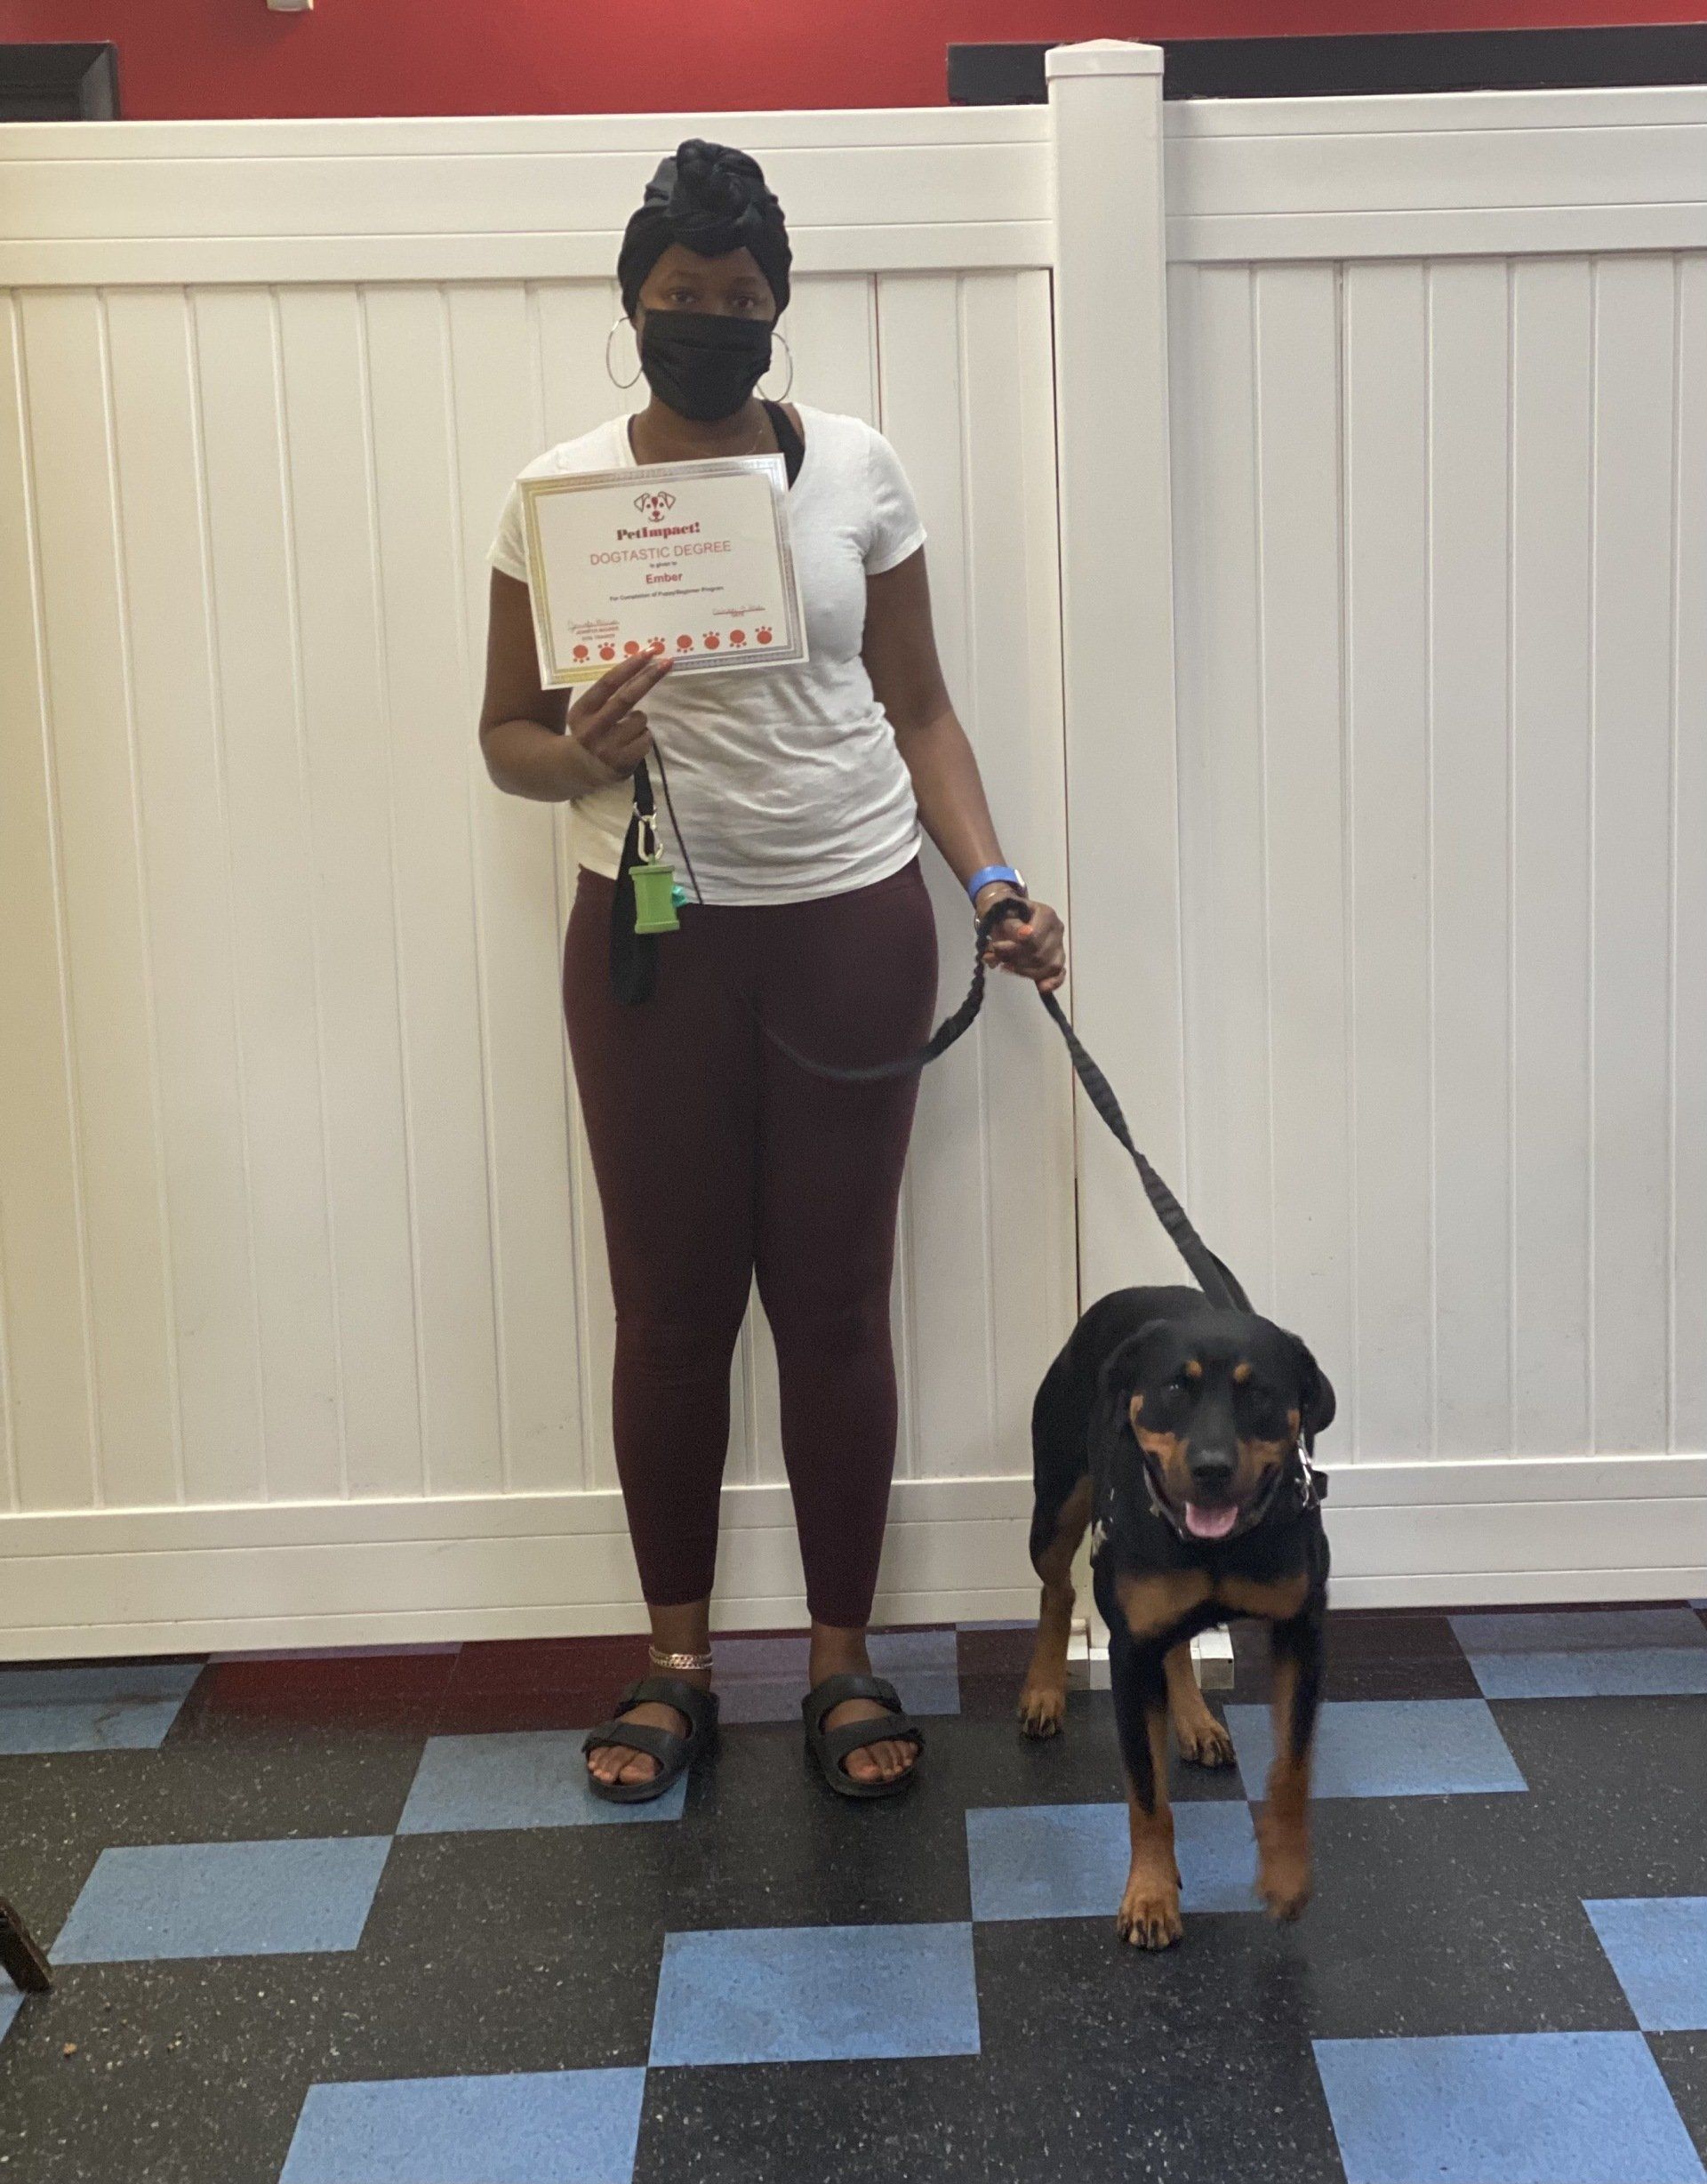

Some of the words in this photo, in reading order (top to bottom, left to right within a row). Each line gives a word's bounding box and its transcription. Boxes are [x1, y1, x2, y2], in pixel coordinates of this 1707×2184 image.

[617, 522, 701, 541] PetImpact!
[590, 546, 670, 566] DOGTASTIC
[674, 541, 732, 557] DEGREE
[645, 573, 683, 584] Ember
